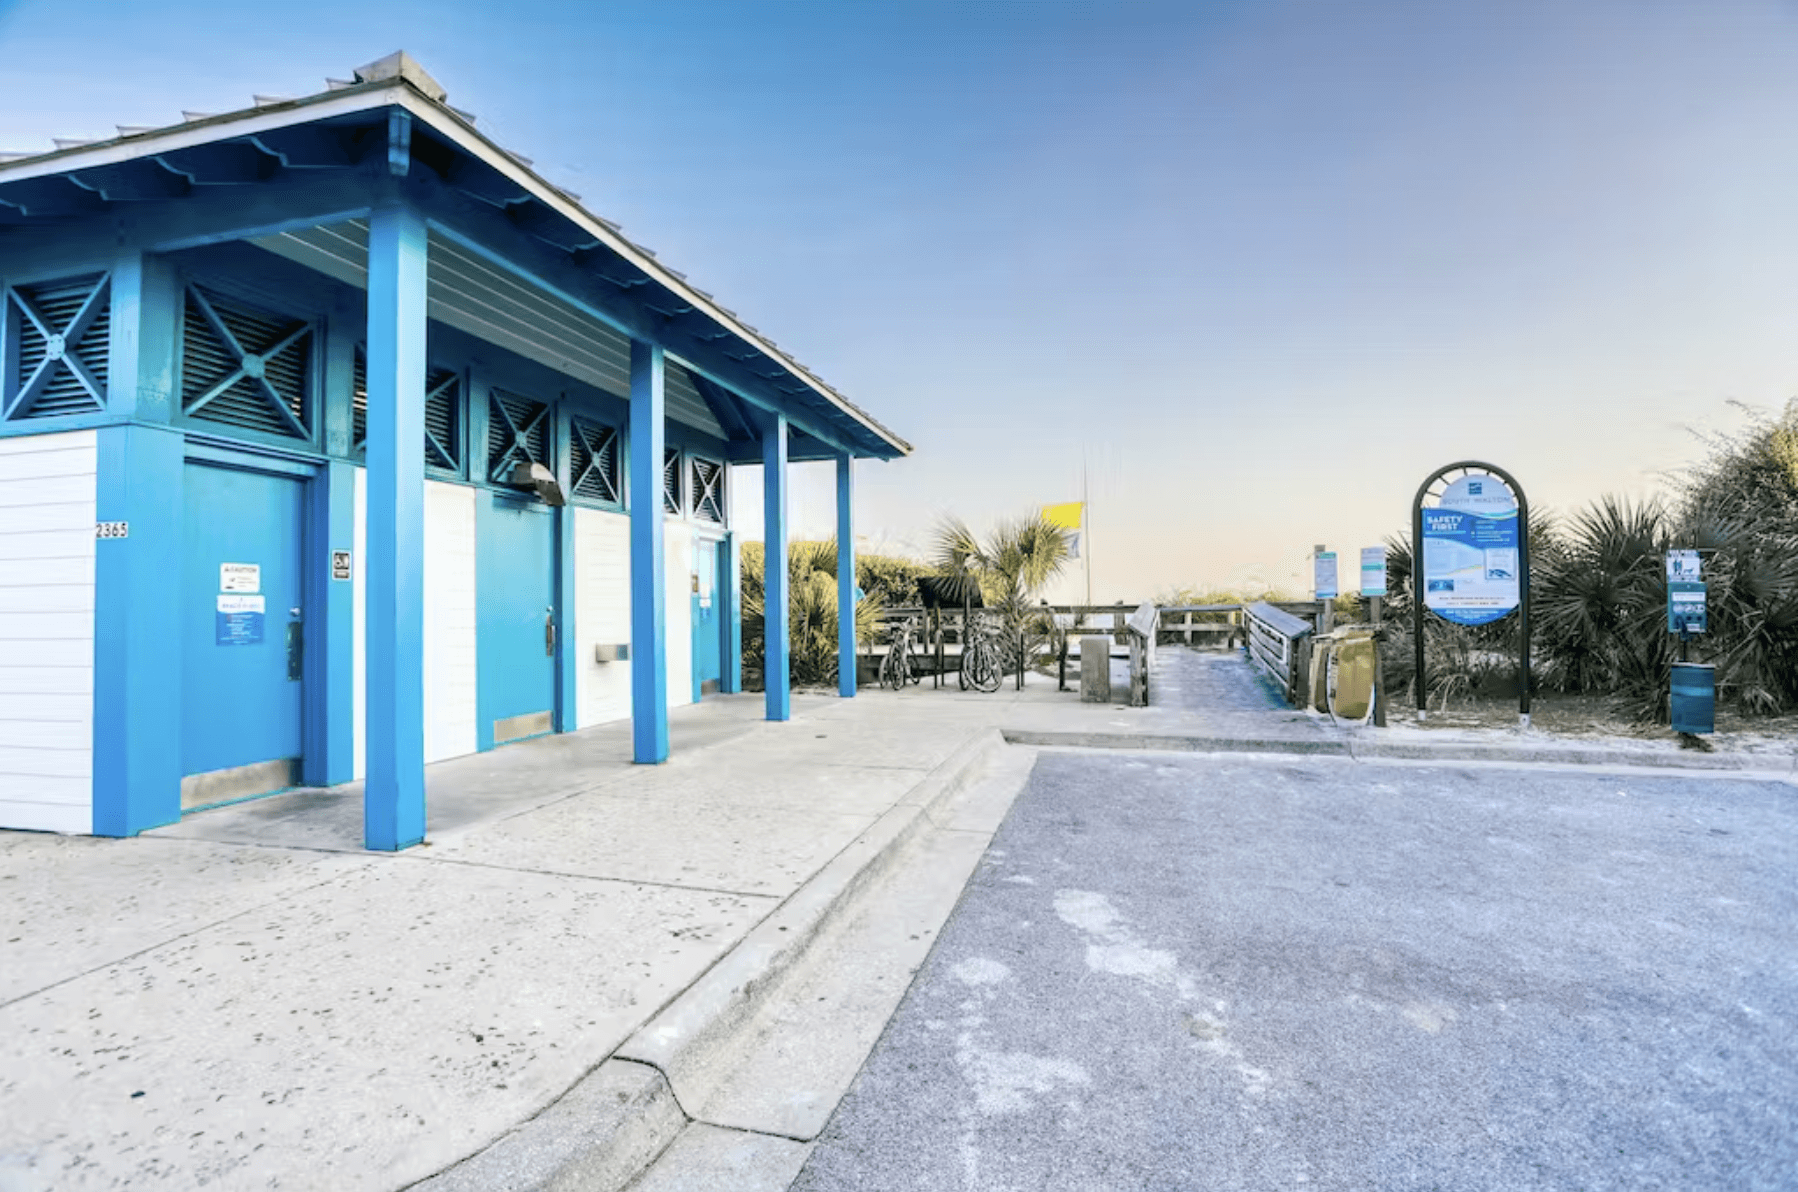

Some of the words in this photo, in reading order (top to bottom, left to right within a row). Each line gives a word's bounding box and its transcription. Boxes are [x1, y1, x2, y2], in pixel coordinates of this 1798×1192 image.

[1427, 516, 1463, 524] SAFETY
[96, 522, 128, 538] 2365
[1431, 523, 1458, 531] FIRST
